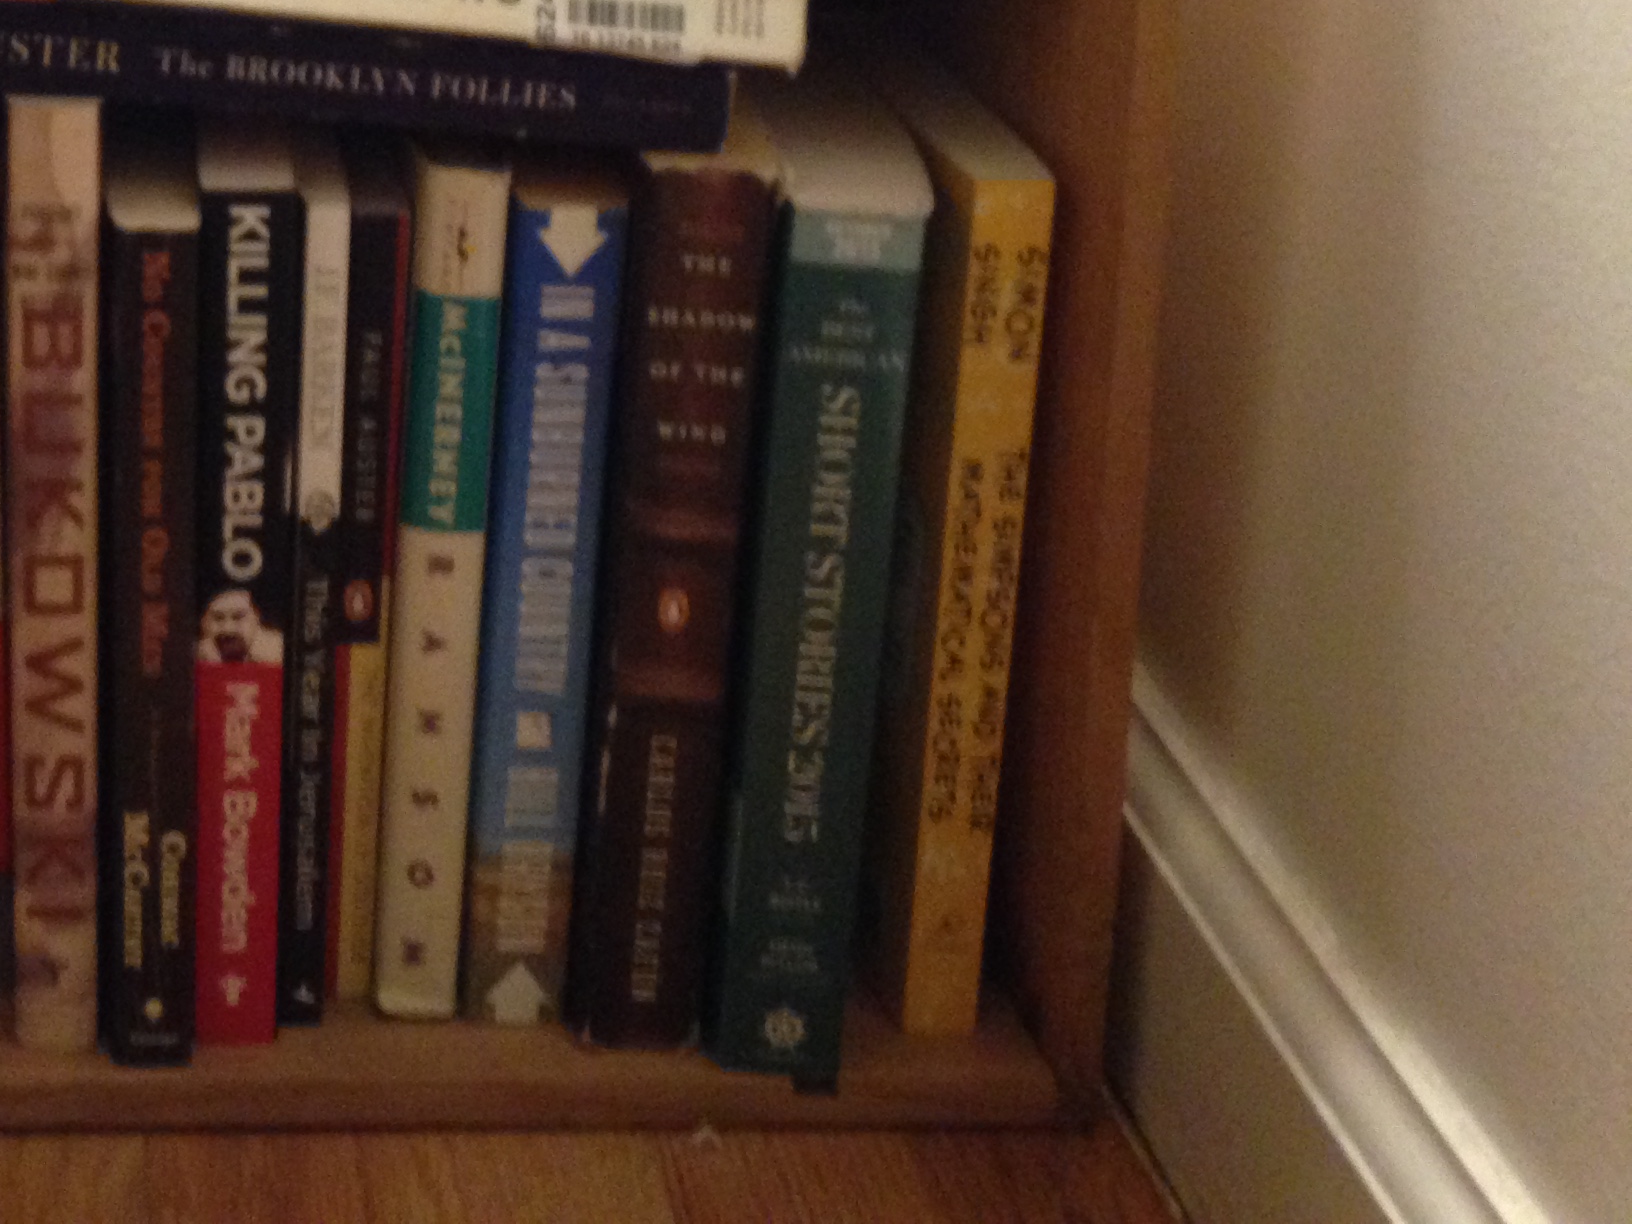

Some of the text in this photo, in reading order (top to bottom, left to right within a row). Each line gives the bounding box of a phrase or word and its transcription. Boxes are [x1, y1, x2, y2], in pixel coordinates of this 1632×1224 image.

[154, 46, 214, 78] The
[226, 55, 415, 96] BROOKLYN
[430, 73, 577, 111] FOLLIES
[683, 253, 733, 276] THE
[970, 243, 1002, 346] SINGH
[1005, 246, 1046, 364] SIMON
[221, 203, 272, 584] KILLING PABLO
[426, 299, 470, 524] McINERNEY
[809, 382, 862, 550] SHORT
[20, 306, 86, 923] BUKOWSKI
[792, 551, 848, 747] STORIES
[218, 682, 260, 954] Mark Bowden
